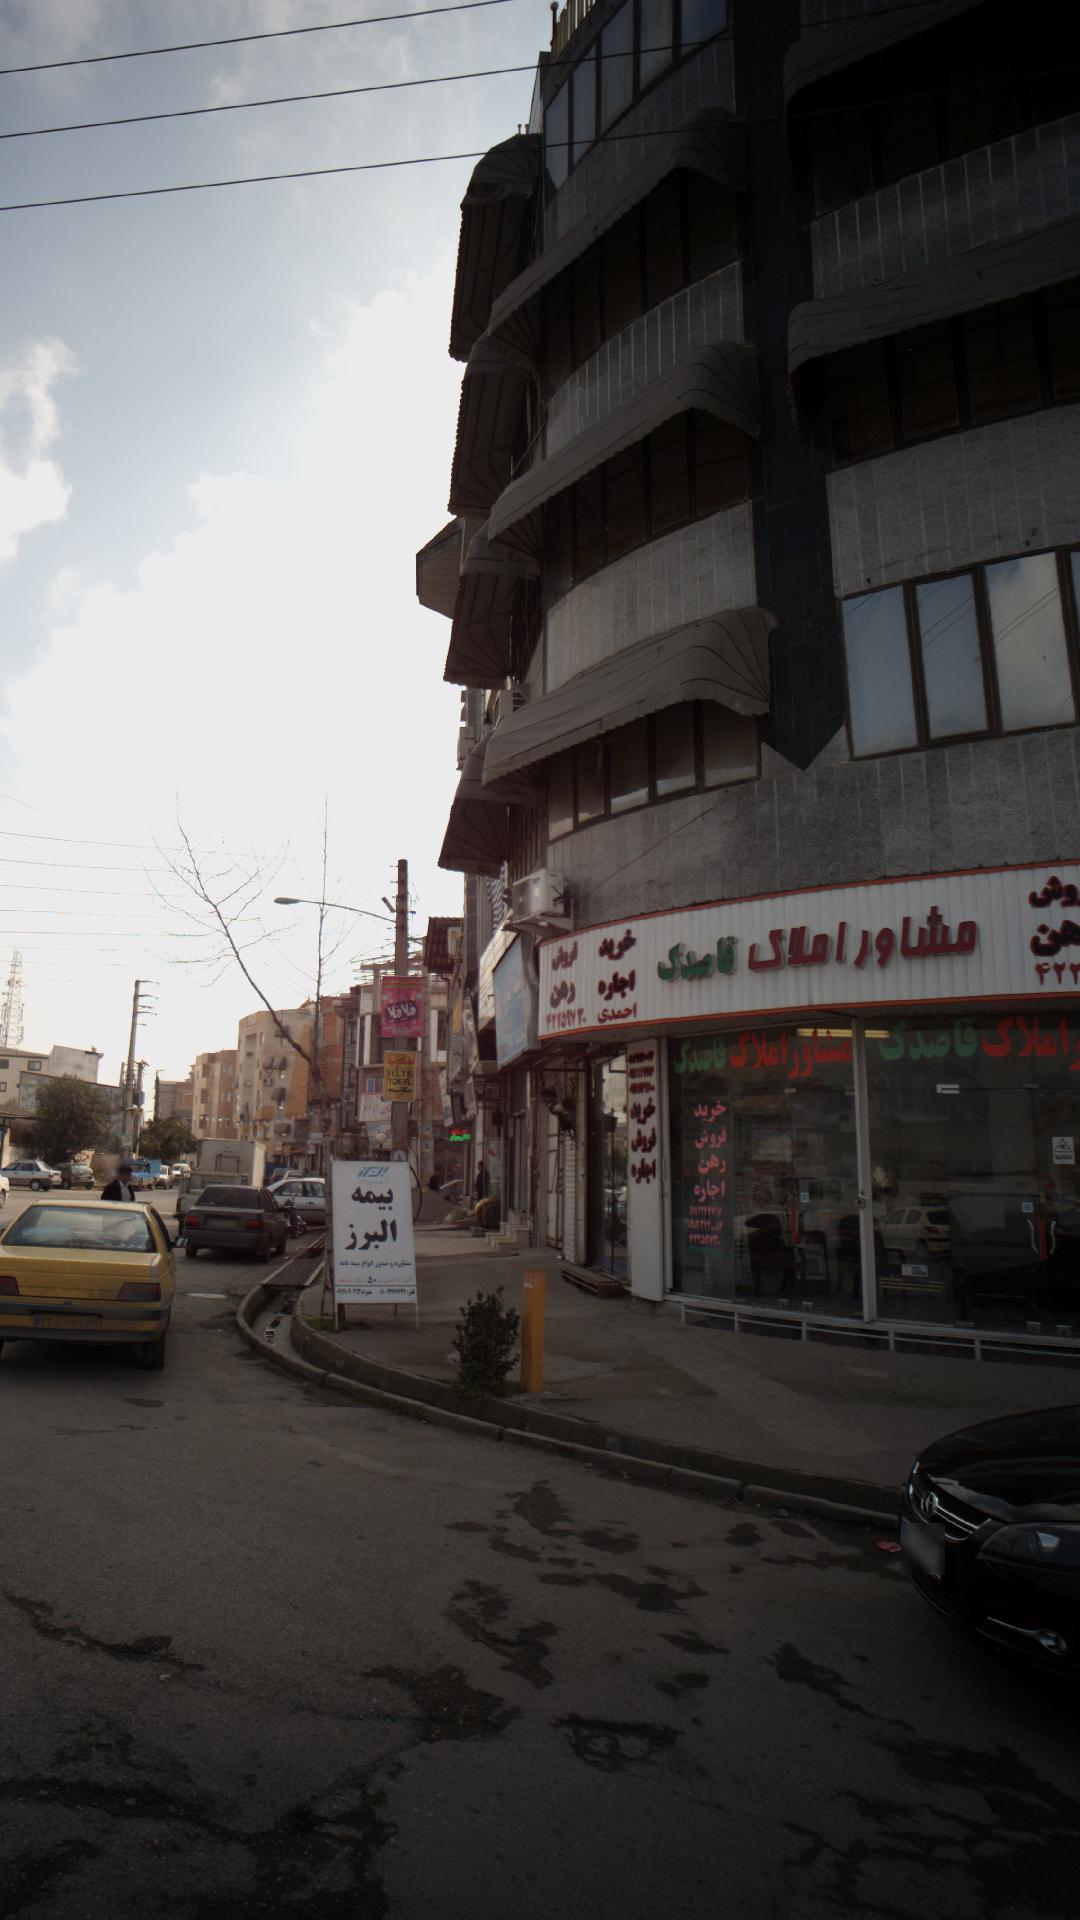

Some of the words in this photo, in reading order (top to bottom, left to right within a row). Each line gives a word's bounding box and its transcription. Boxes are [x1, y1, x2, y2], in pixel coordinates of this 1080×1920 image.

[599, 929, 636, 960] خرید
[748, 921, 847, 972] املاک
[854, 906, 977, 969] مشاور
[552, 941, 578, 970] فروش
[658, 935, 739, 981] قاصدک
[550, 981, 576, 1008] رهن
[598, 970, 635, 1001] اجاره
[598, 1002, 637, 1024] احمدی
[880, 1016, 978, 1061] قاصدک
[981, 1011, 1068, 1057] املاک
[672, 1035, 727, 1073] قاصدک
[728, 1029, 787, 1070] املاک
[787, 1026, 852, 1079] مشاور
[630, 1097, 656, 1124] خرید
[694, 1100, 727, 1123] خرید
[632, 1126, 656, 1152] فروش
[695, 1127, 727, 1149] فروش
[631, 1158, 656, 1185] اجاره
[697, 1154, 726, 1175] رهن
[352, 1186, 394, 1212] بیمه
[693, 1179, 725, 1202] اجاره
[345, 1218, 398, 1251] البرز
